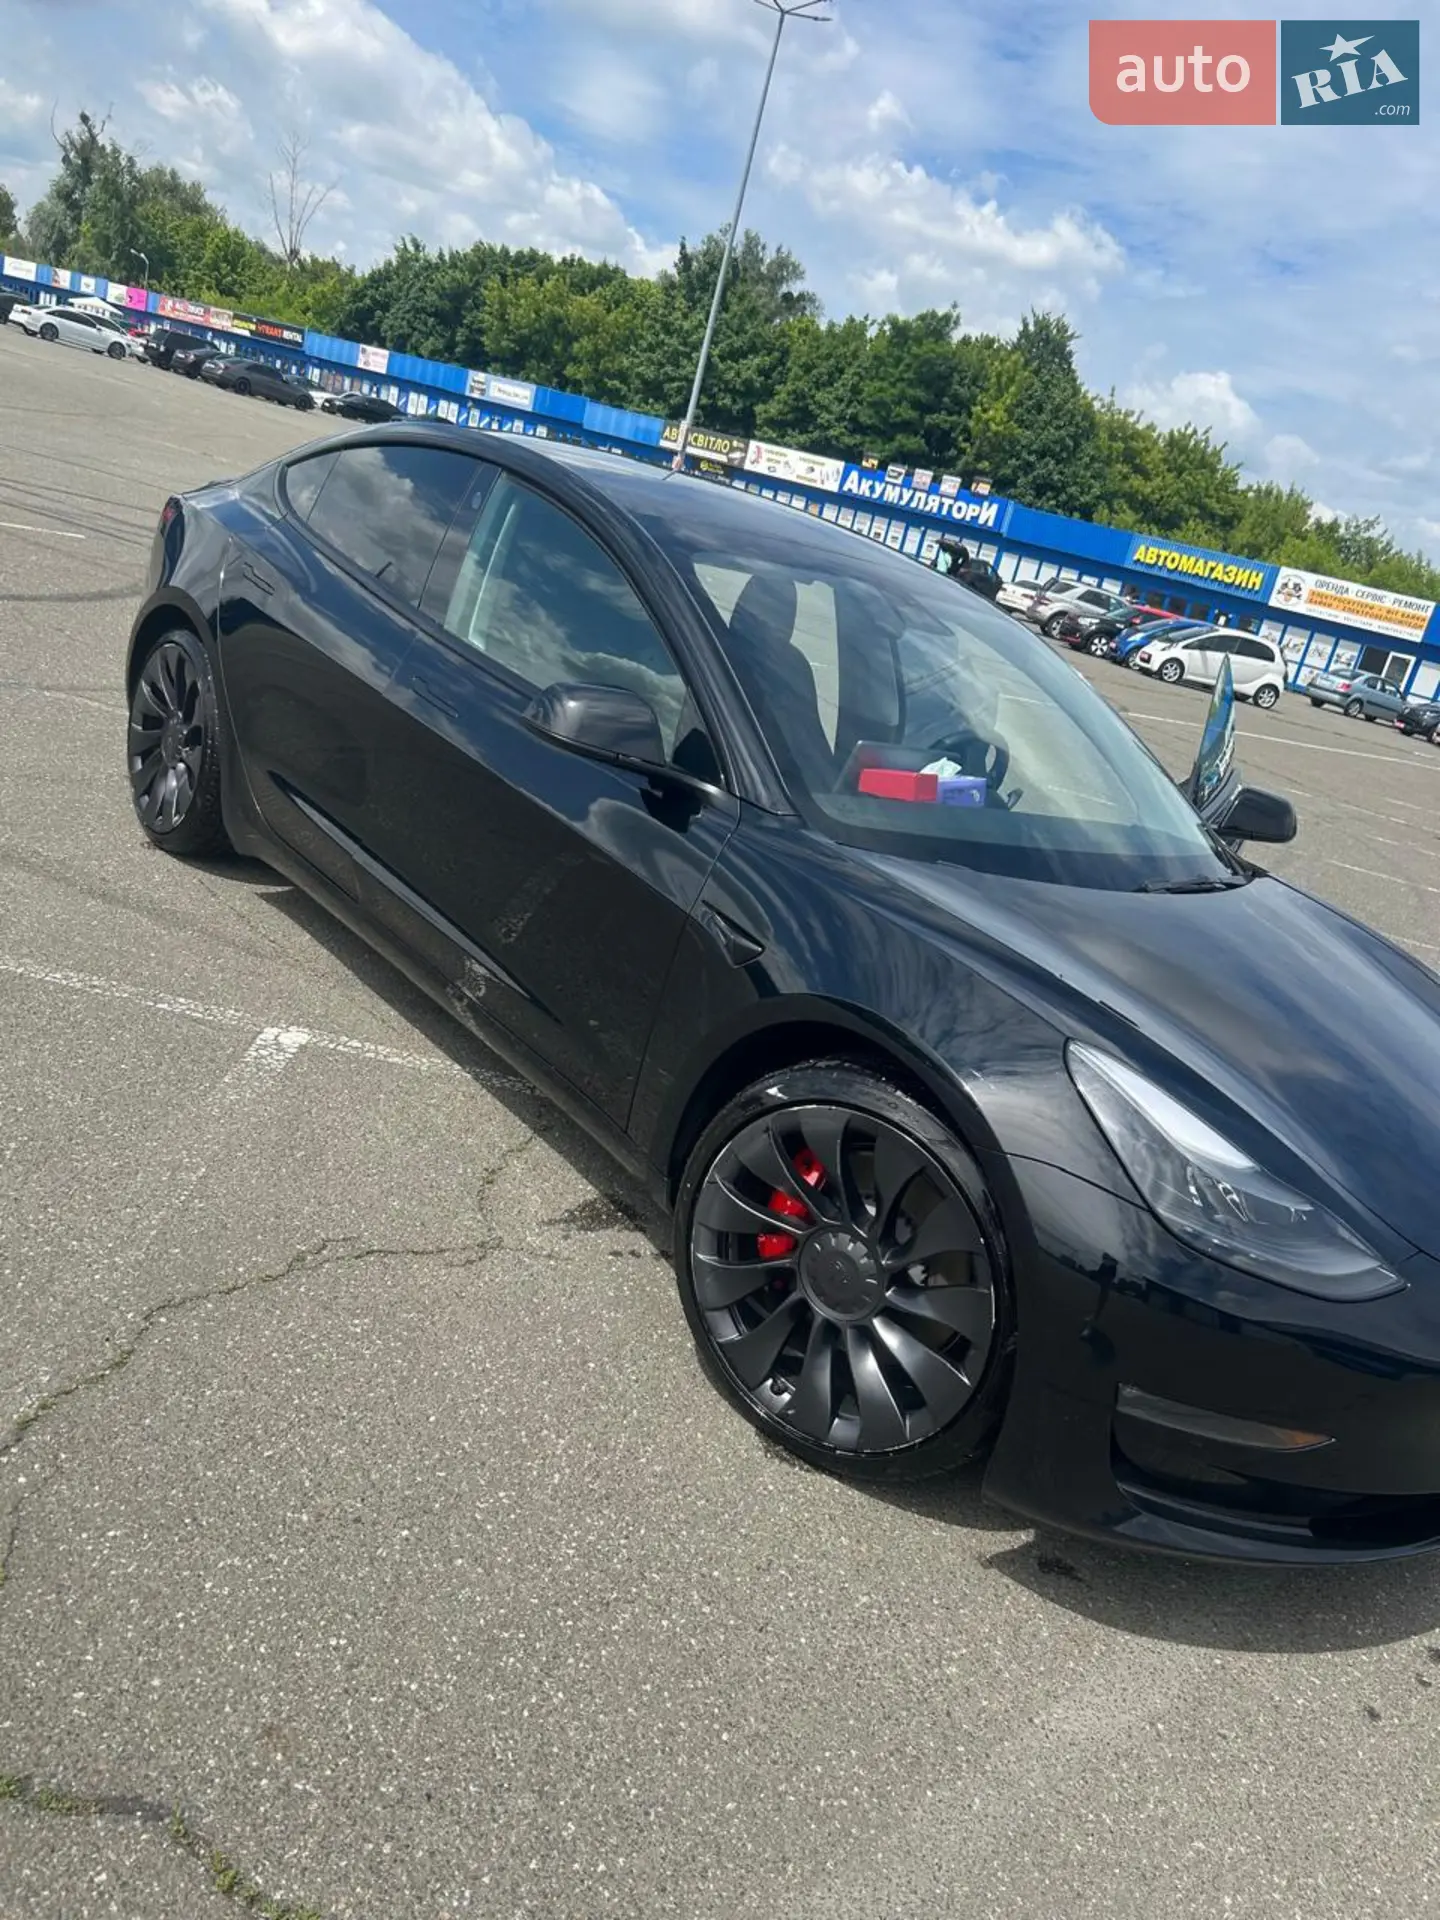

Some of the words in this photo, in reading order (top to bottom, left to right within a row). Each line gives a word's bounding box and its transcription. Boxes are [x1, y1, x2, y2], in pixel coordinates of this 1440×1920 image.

[663, 425, 731, 453] АВСВІТЛО
[1133, 544, 1264, 590] АВТОМАГАЗИН
[1315, 579, 1350, 596] ОРЕНДА
[1355, 589, 1387, 604] СЕРВІС
[1392, 598, 1431, 613] РЕМОНТ
